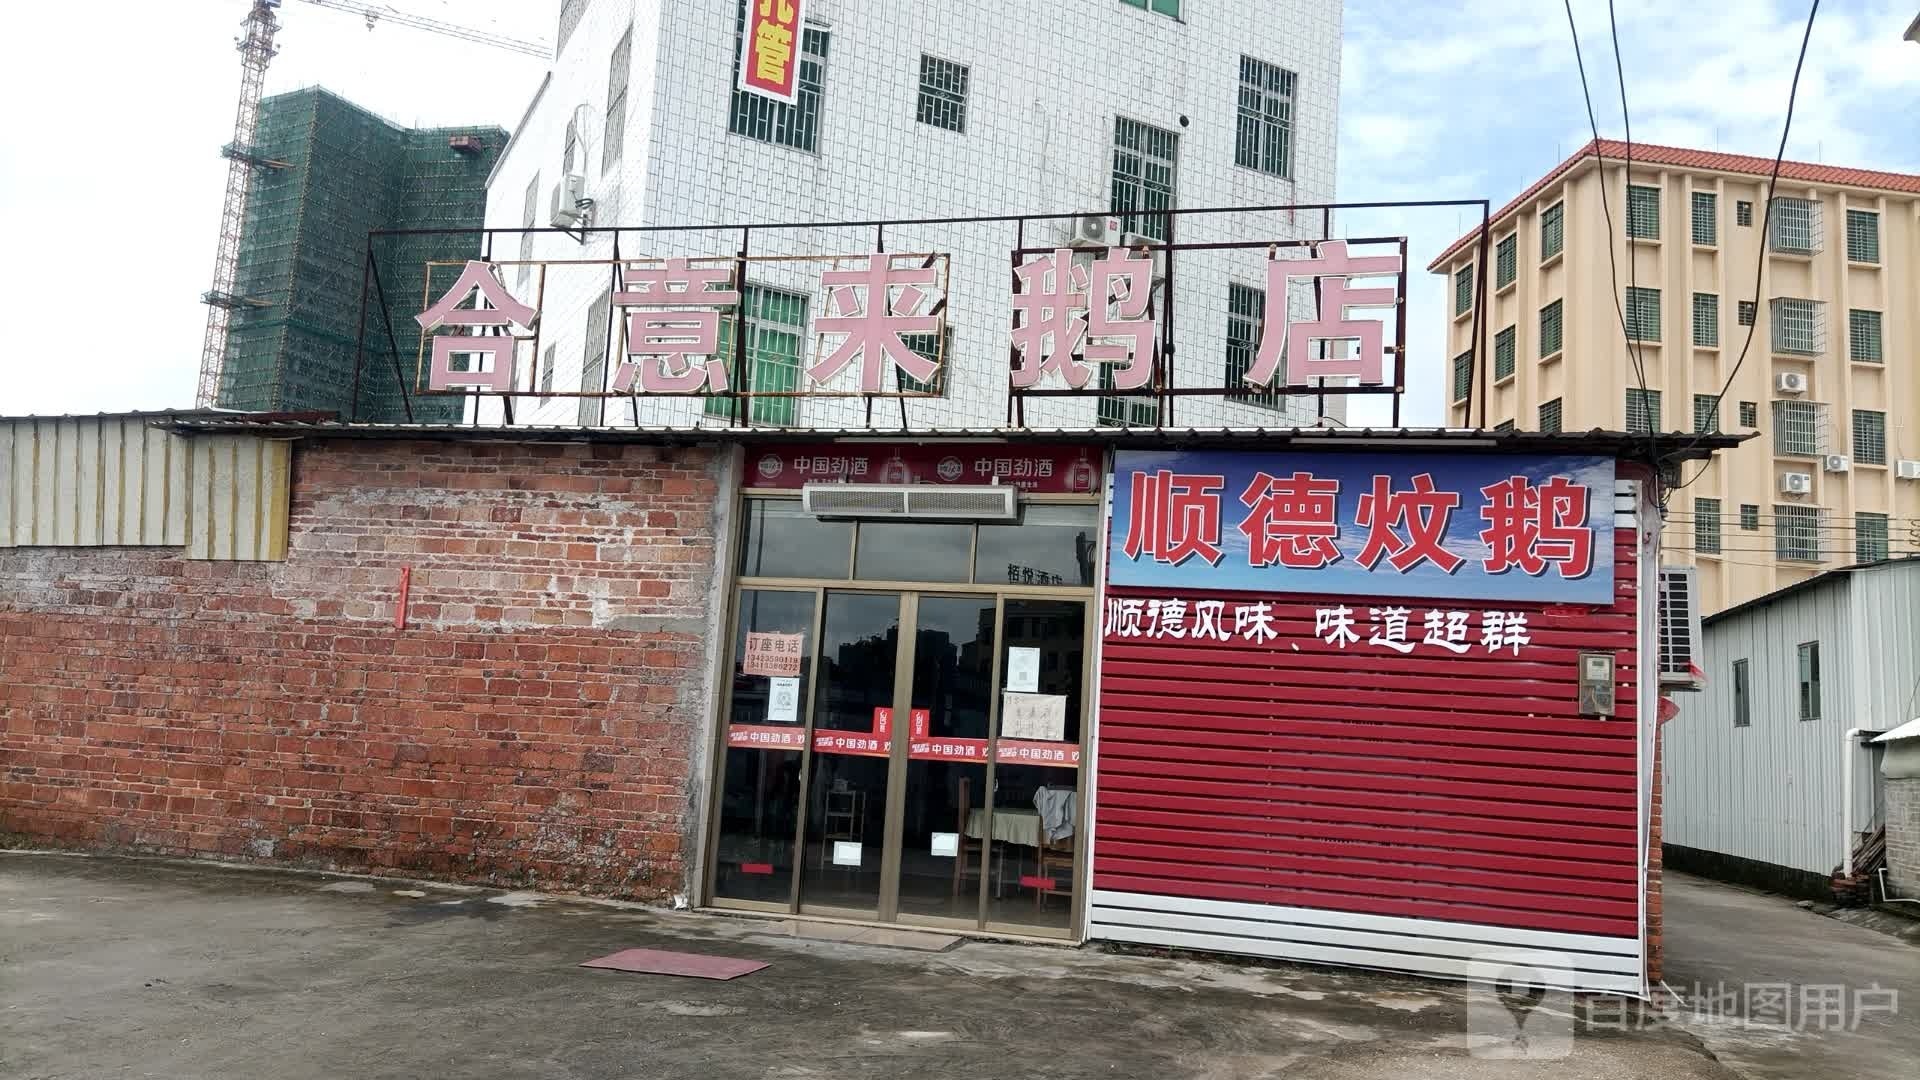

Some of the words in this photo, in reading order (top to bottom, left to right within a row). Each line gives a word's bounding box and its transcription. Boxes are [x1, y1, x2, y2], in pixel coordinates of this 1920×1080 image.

[415, 240, 1403, 394] 合意来鹅店
[793, 455, 869, 476] 中国劲酒
[974, 457, 1054, 478] 中国劲酒
[1123, 470, 1595, 578] 顺德炆鹅
[748, 637, 800, 653] 订座电话
[750, 732, 792, 745] 中国劲酒
[835, 738, 878, 751] 中国劲酒
[931, 744, 976, 756] 中国劲酒
[1019, 747, 1065, 761] 中国劲酒
